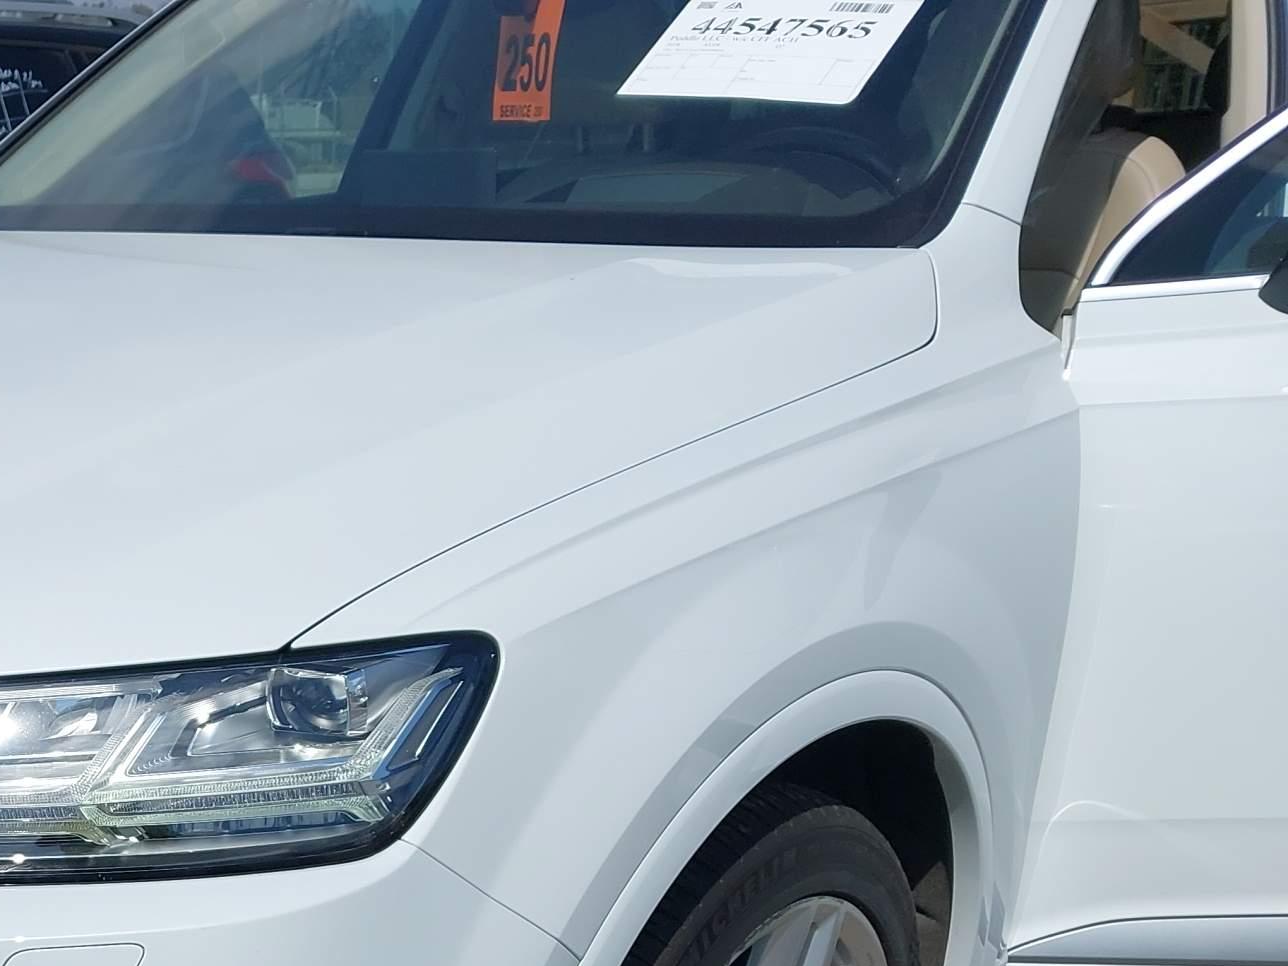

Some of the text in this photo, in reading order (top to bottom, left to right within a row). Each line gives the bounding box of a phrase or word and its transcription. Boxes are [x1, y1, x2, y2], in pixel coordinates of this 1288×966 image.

[691, 16, 878, 39] 44547565
[502, 33, 551, 92] 250
[500, 104, 532, 118] SERVICE
